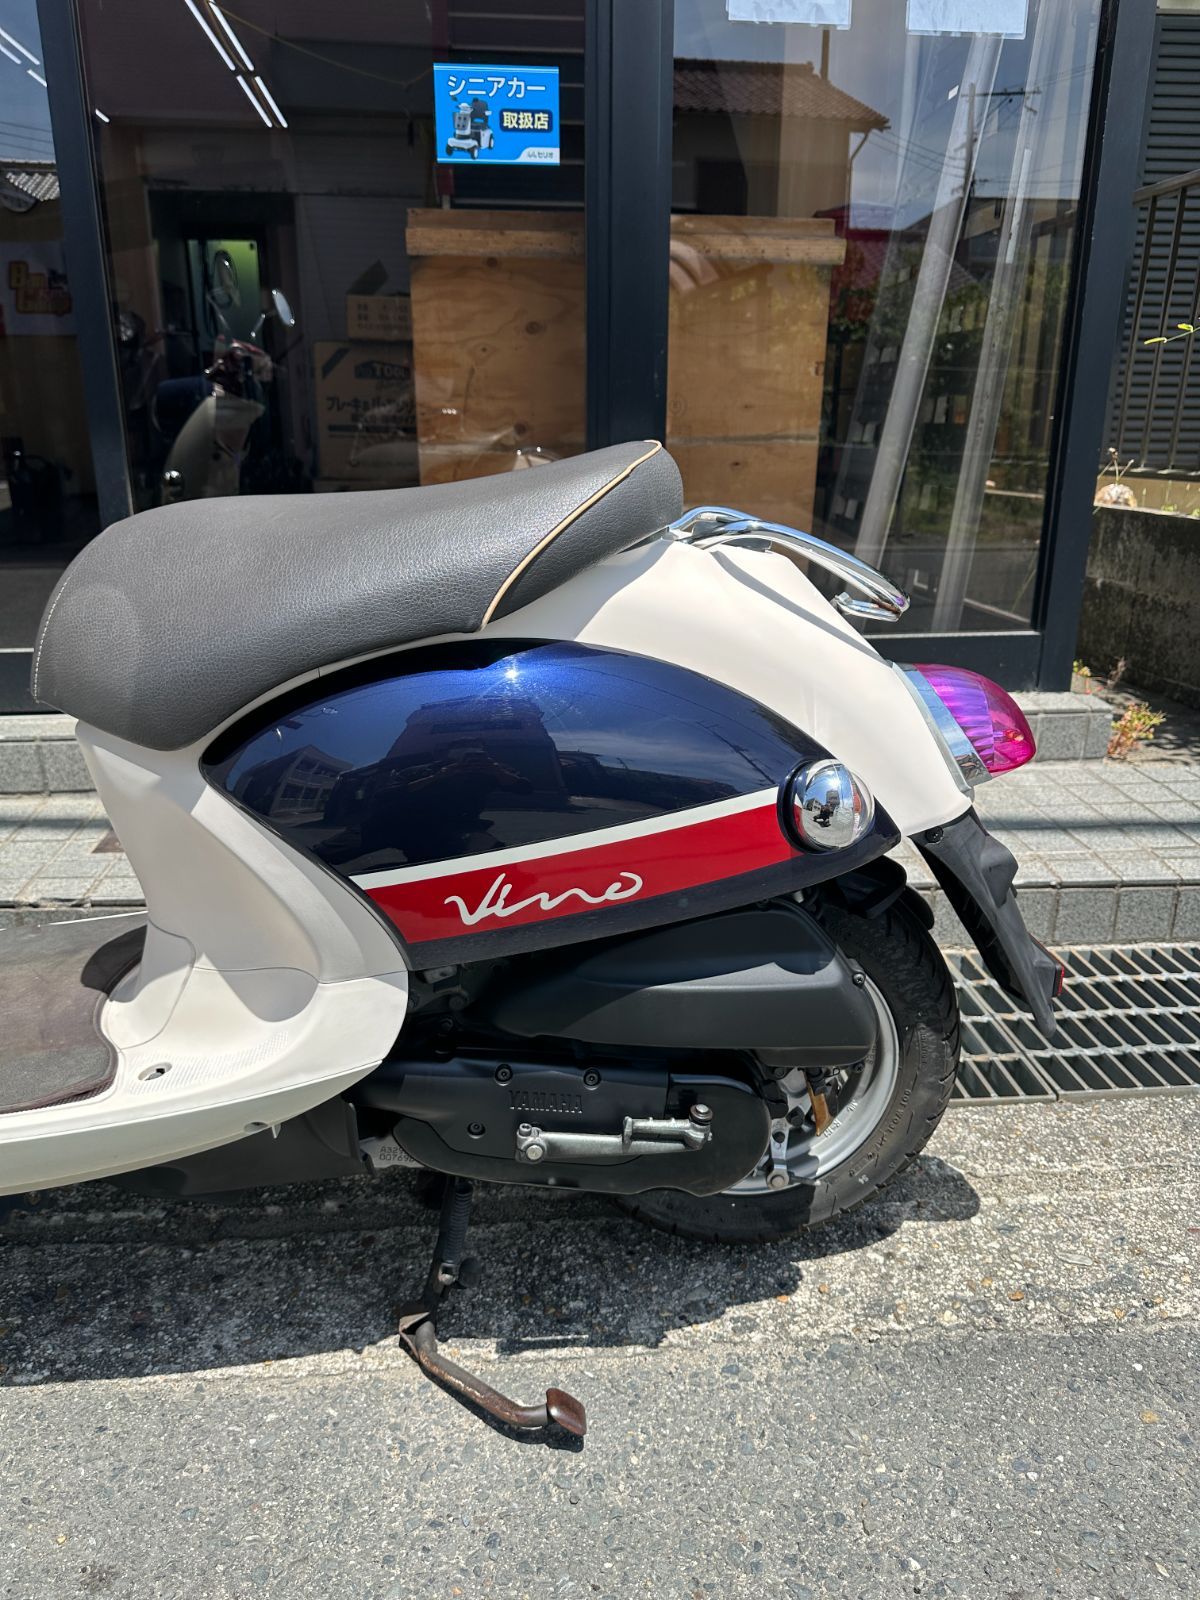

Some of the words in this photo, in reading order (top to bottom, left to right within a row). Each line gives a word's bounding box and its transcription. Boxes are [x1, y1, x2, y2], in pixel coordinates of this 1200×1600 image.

[447, 75, 546, 98] シニアカー
[502, 111, 549, 130] 取扱店
[444, 871, 643, 925] Vino
[508, 1090, 583, 1114] YAMAHA
